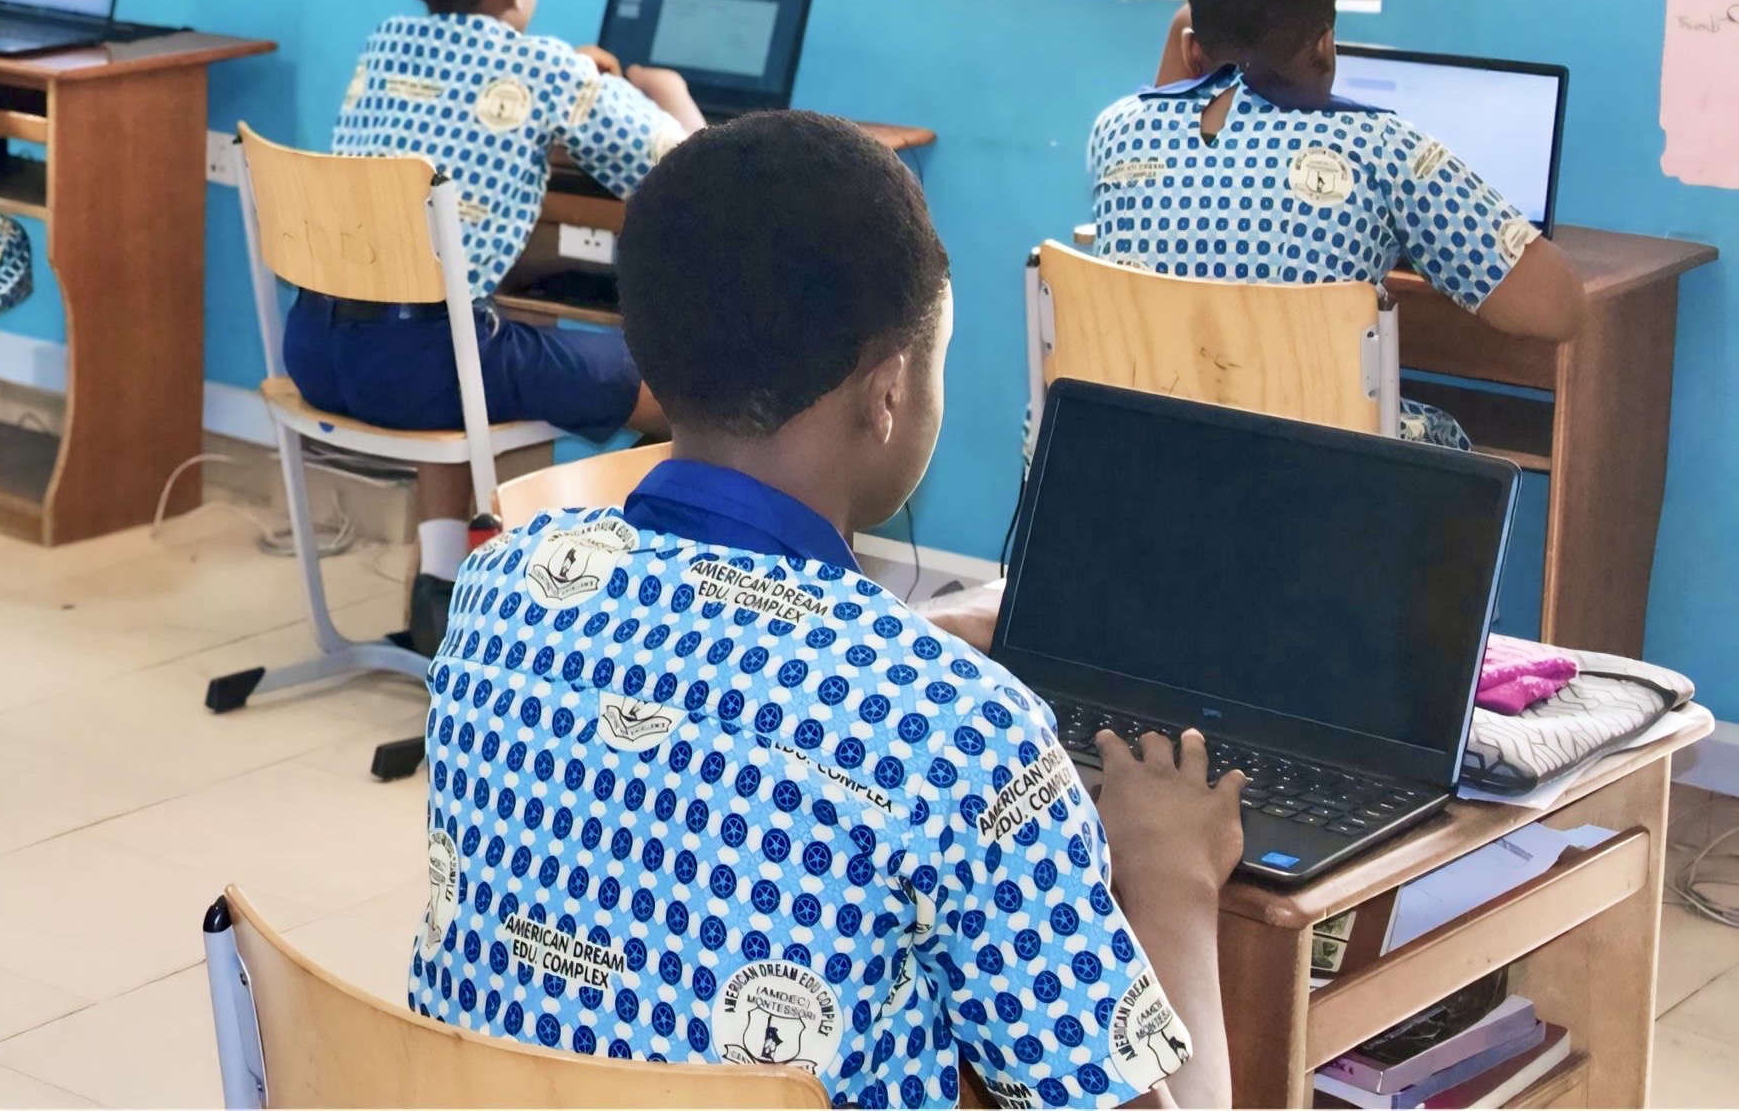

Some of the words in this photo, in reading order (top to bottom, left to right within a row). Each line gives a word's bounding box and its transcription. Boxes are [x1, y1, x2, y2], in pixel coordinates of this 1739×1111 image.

[690, 560, 771, 594] AMERICAN
[771, 583, 829, 617] DREAM
[698, 580, 730, 602] EDU.
[734, 591, 806, 624] COMPLEX
[978, 763, 1044, 837] AMERICAN
[994, 806, 1030, 841] EDU.
[504, 915, 571, 954] AMERICAN
[572, 940, 624, 974] DREAM
[512, 938, 539, 965] EDU.
[542, 951, 610, 990] COMPLEX
[724, 966, 759, 1013] AMERICAN
[758, 963, 799, 982] DREAM
